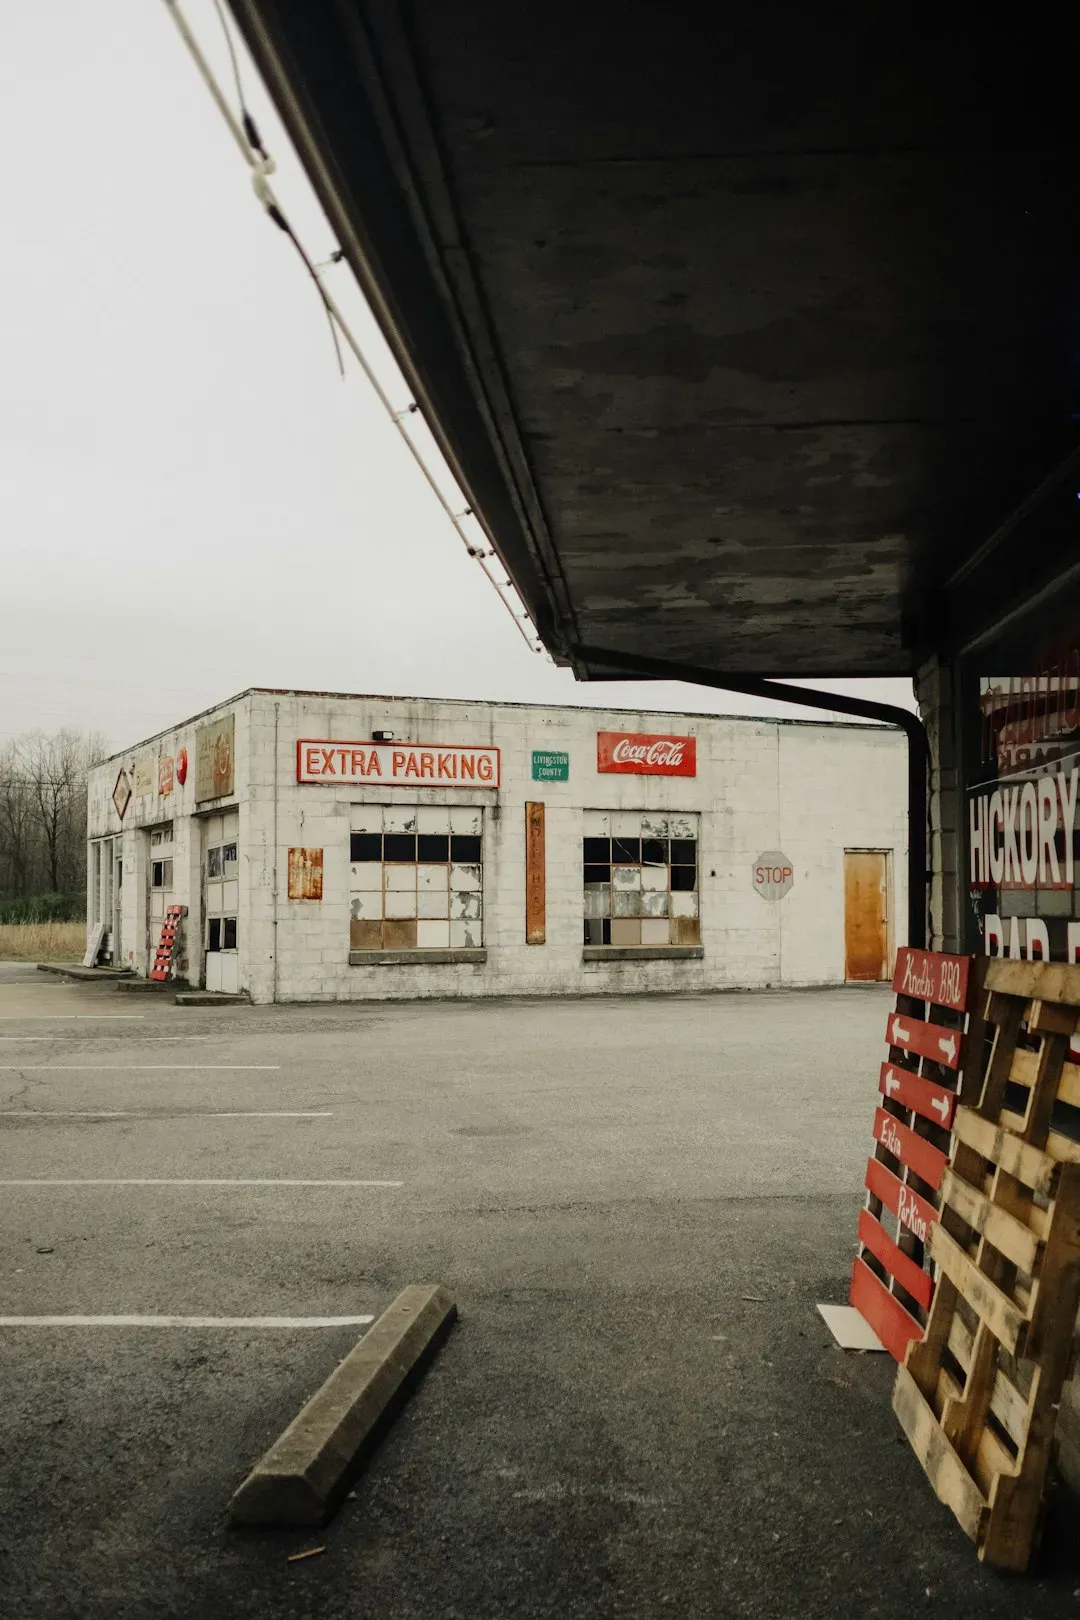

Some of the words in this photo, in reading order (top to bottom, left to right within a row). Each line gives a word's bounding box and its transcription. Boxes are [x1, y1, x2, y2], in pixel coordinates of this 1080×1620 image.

[306, 748, 382, 777] EXTRA
[392, 751, 493, 781] PARKING
[613, 739, 686, 766] Coca-Cola
[538, 767, 562, 777] COUNTY
[969, 767, 1079, 884] HICKORY
[756, 866, 792, 884] STOP
[938, 960, 961, 1004] BBQ
[881, 1117, 901, 1157] Extra
